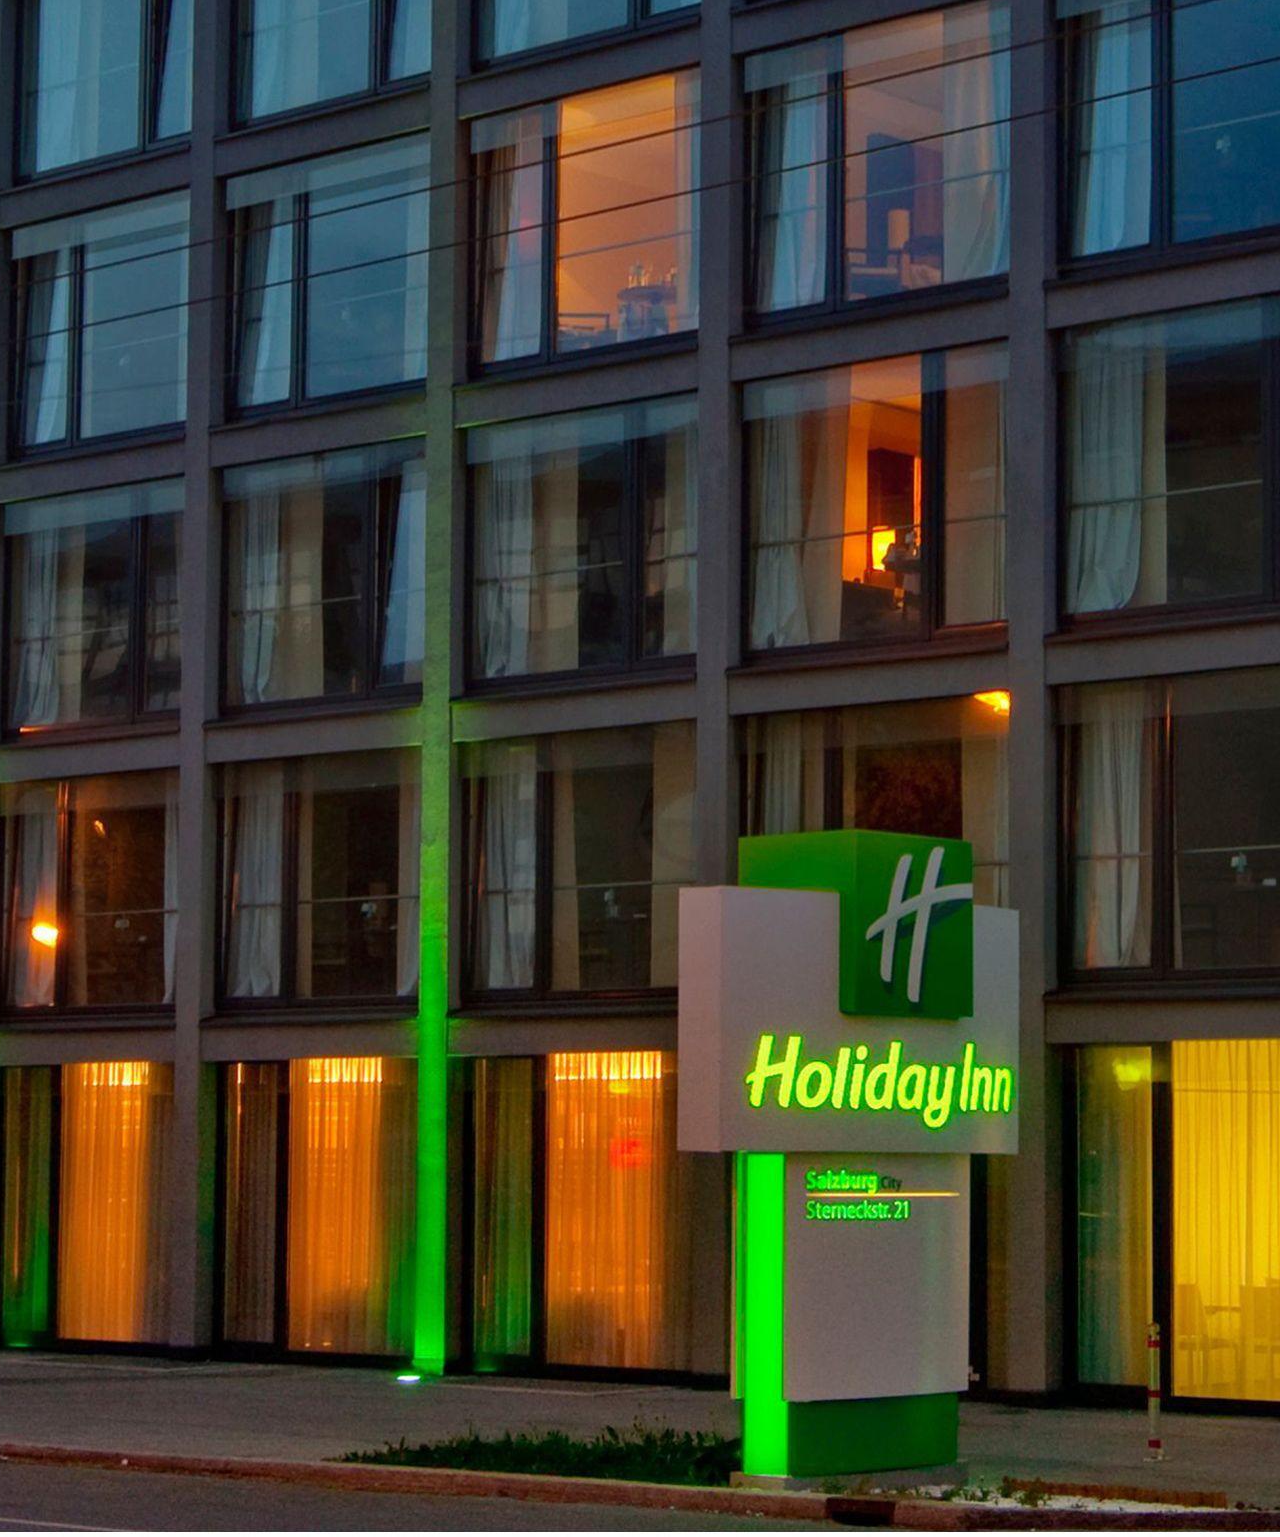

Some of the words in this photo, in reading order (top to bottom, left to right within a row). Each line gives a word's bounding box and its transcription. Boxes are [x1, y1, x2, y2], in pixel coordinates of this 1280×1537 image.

[745, 1034, 956, 1129] Holiday
[958, 1042, 1012, 1113] Inn
[805, 1169, 879, 1197] Salzburg
[881, 1175, 903, 1193] City
[805, 1200, 892, 1220] Sterneckstr.
[894, 1200, 909, 1220] 21
